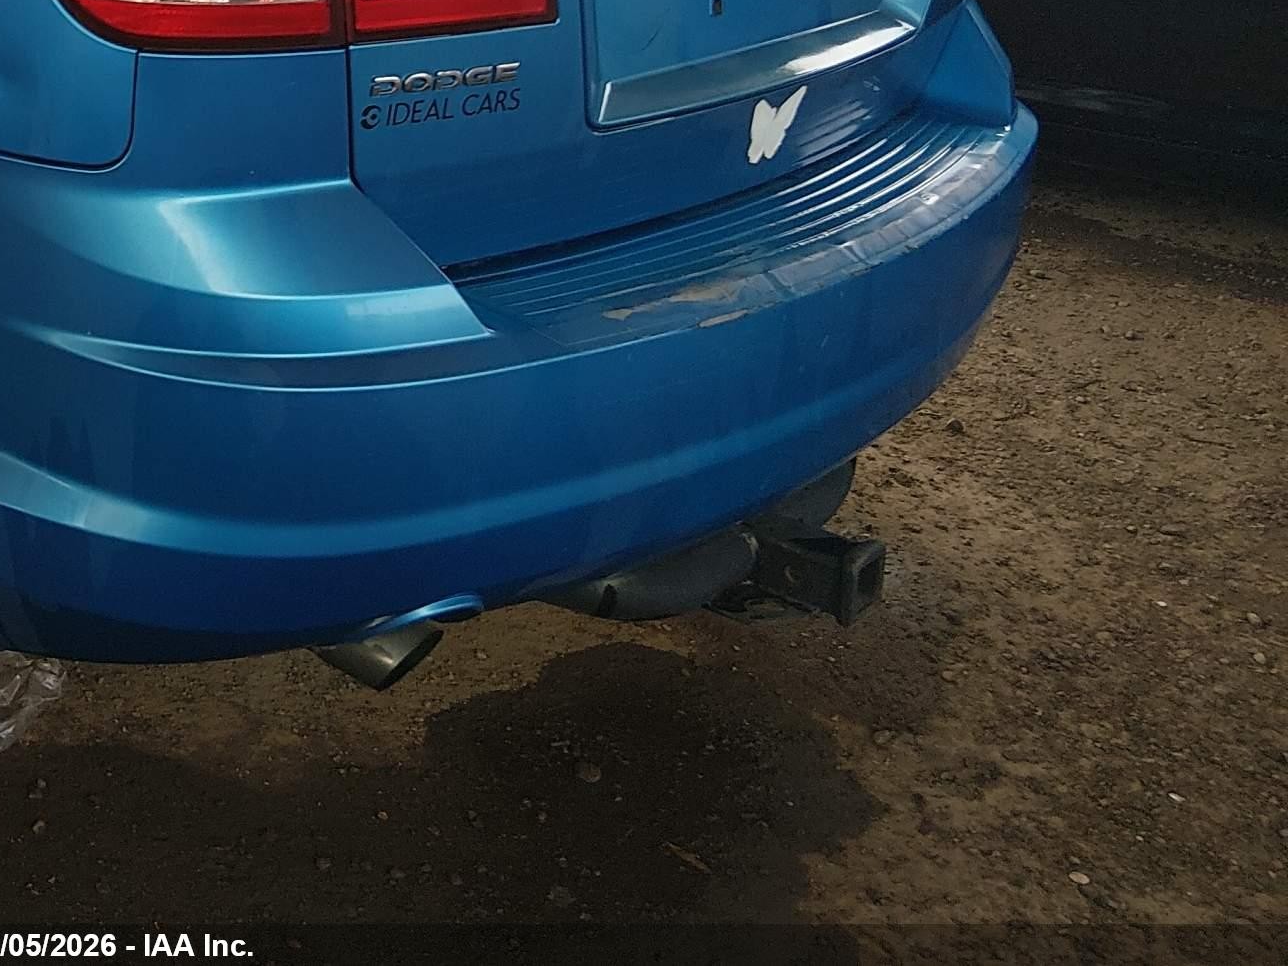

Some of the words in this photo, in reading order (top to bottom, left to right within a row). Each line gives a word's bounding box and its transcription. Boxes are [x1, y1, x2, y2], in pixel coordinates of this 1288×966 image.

[371, 61, 521, 98] DODGE
[386, 97, 455, 127] IDEAL
[462, 88, 521, 117] CARS
